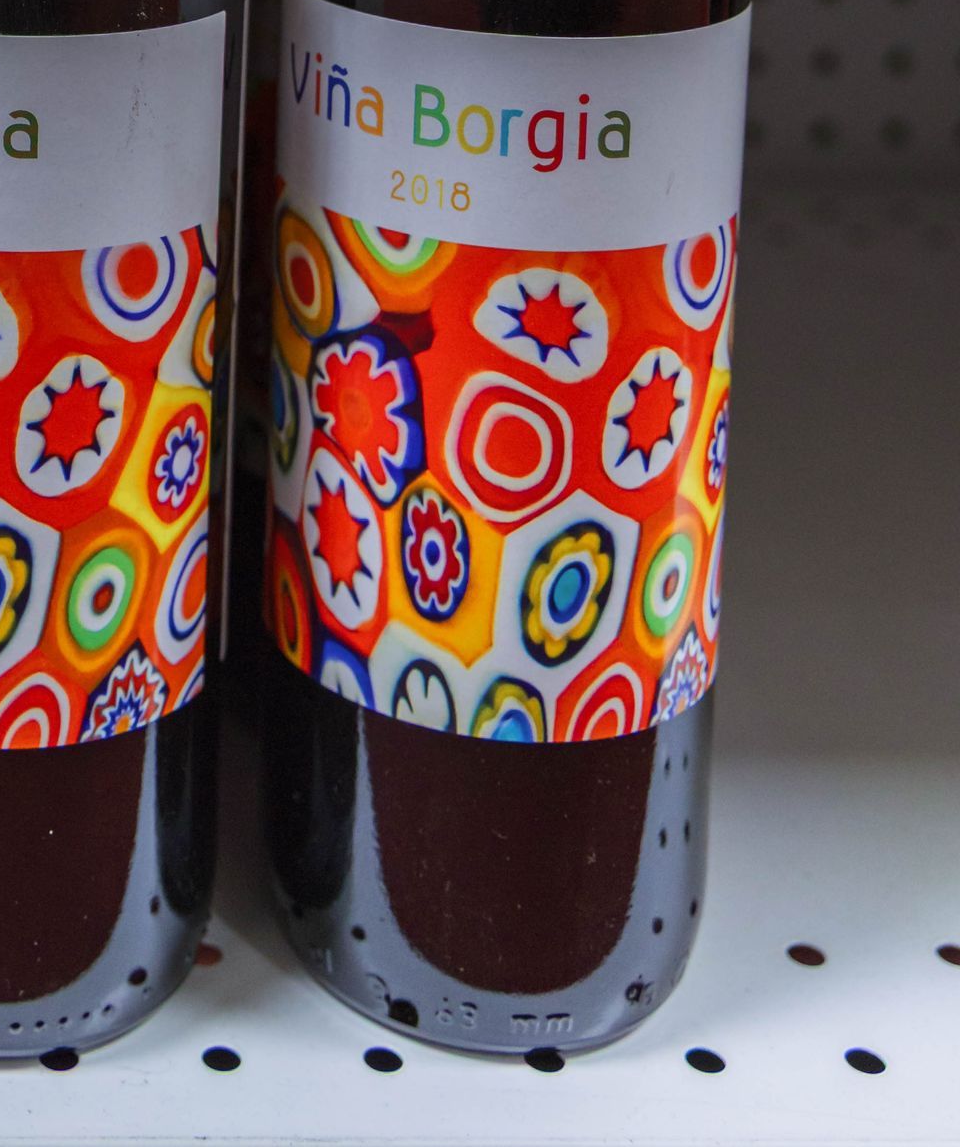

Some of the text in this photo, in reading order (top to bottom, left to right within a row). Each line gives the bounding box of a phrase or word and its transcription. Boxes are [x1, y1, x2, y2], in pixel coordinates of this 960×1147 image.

[290, 41, 631, 173] Viña Borgia
[390, 169, 471, 212] 2018
